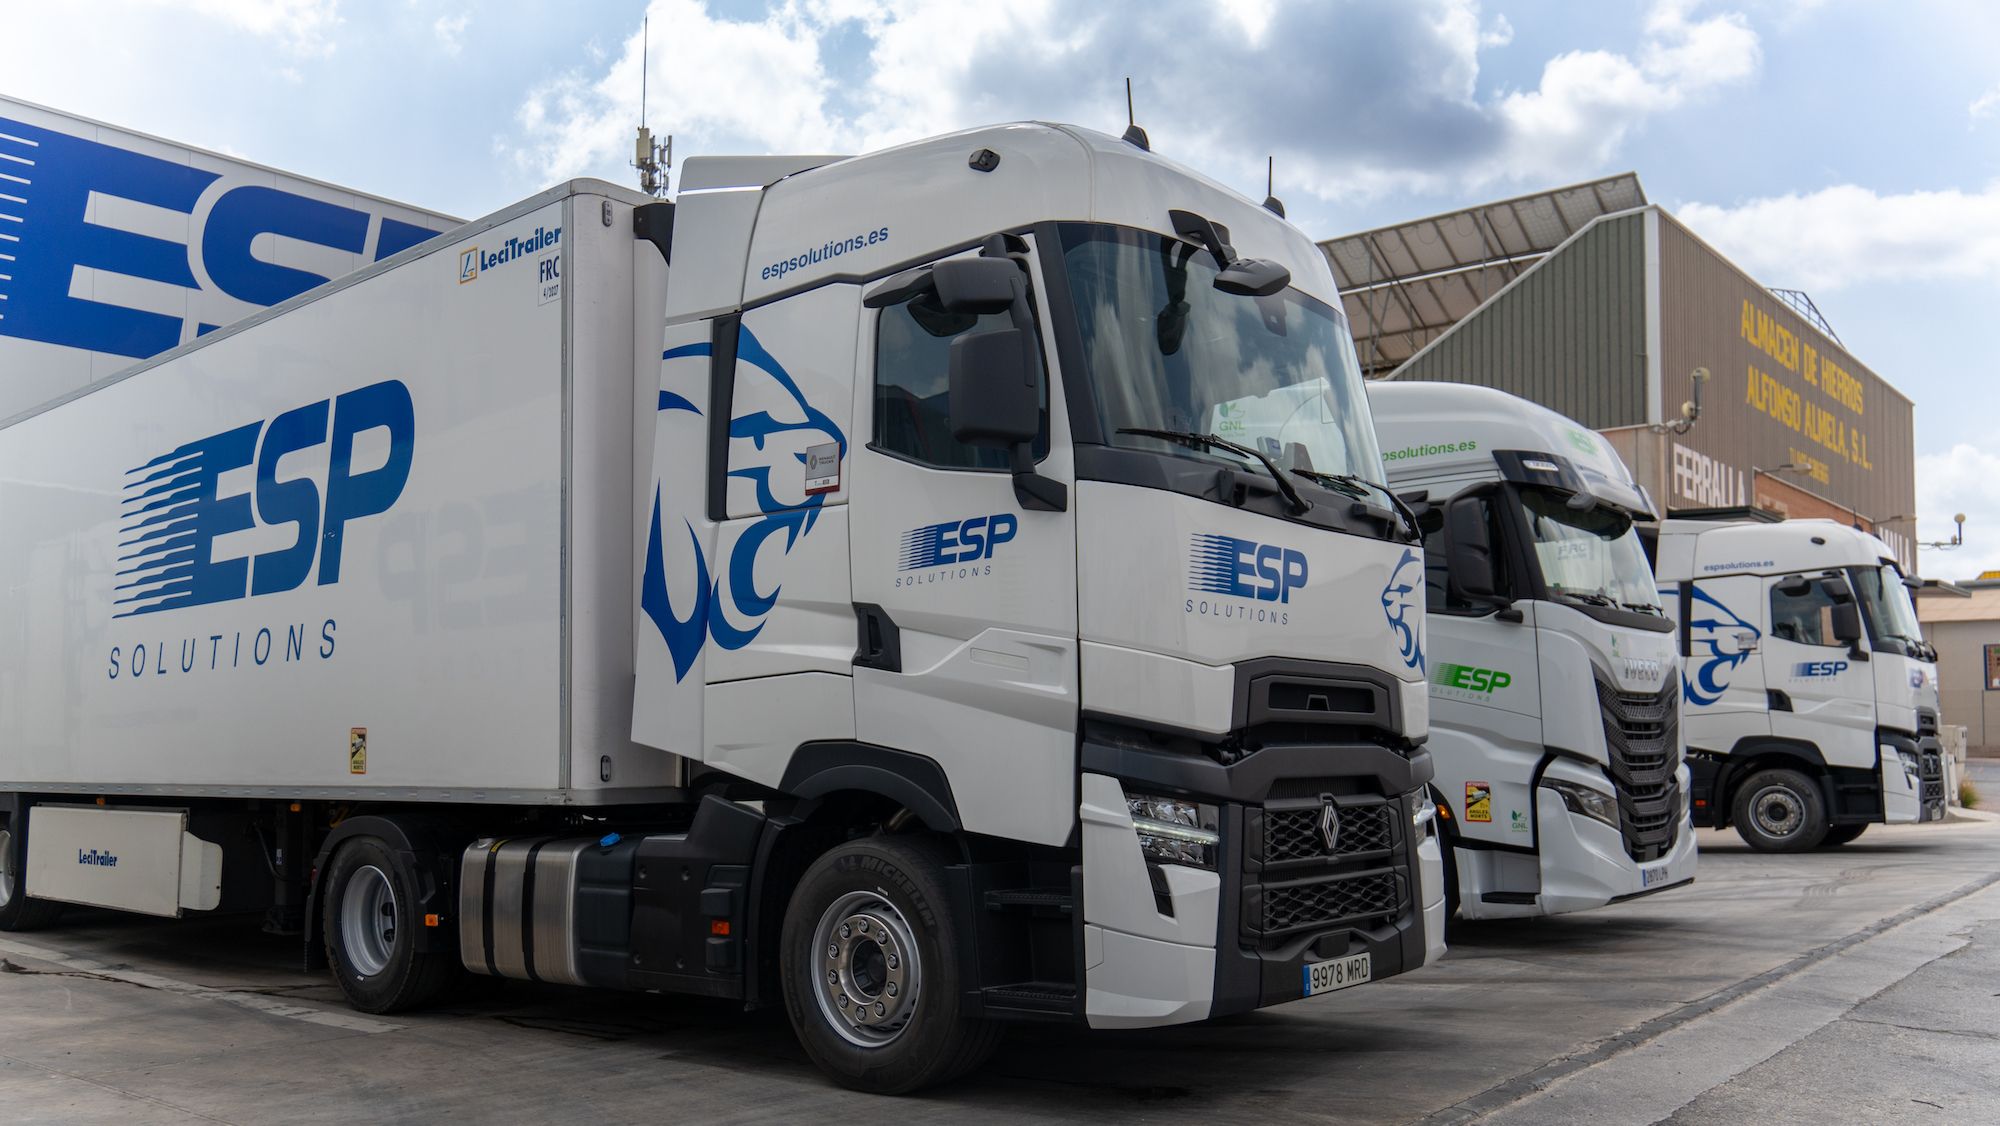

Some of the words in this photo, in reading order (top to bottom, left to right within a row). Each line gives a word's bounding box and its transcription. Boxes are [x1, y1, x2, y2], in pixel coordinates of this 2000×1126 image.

[0, 116, 445, 359] ES
[480, 227, 562, 271] LeciTrailer
[762, 227, 889, 281] espsolutions.es
[540, 256, 560, 283] FRC
[1741, 299, 1799, 373] ALMACEN
[1804, 342, 1817, 386] DE
[1821, 355, 1863, 415] HIERROS
[1746, 364, 1801, 432] ALFONSO
[1219, 420, 1246, 432] GNL
[150, 379, 415, 615] ESP
[1673, 442, 1746, 508] FERRALLA
[909, 513, 1018, 569] ESP
[896, 565, 992, 588] SOLUTIONS
[1200, 535, 1309, 604] ESP
[1703, 560, 1775, 572] espsolutions.es
[1185, 599, 1289, 626] SOLUTIONS
[108, 619, 338, 680] SOLUTIONS
[1800, 661, 1849, 677] ESP
[1445, 664, 1512, 694] ESP
[79, 848, 118, 867] LeciTrailer
[1312, 962, 1343, 989] 9978
[1347, 957, 1369, 982] MRD
